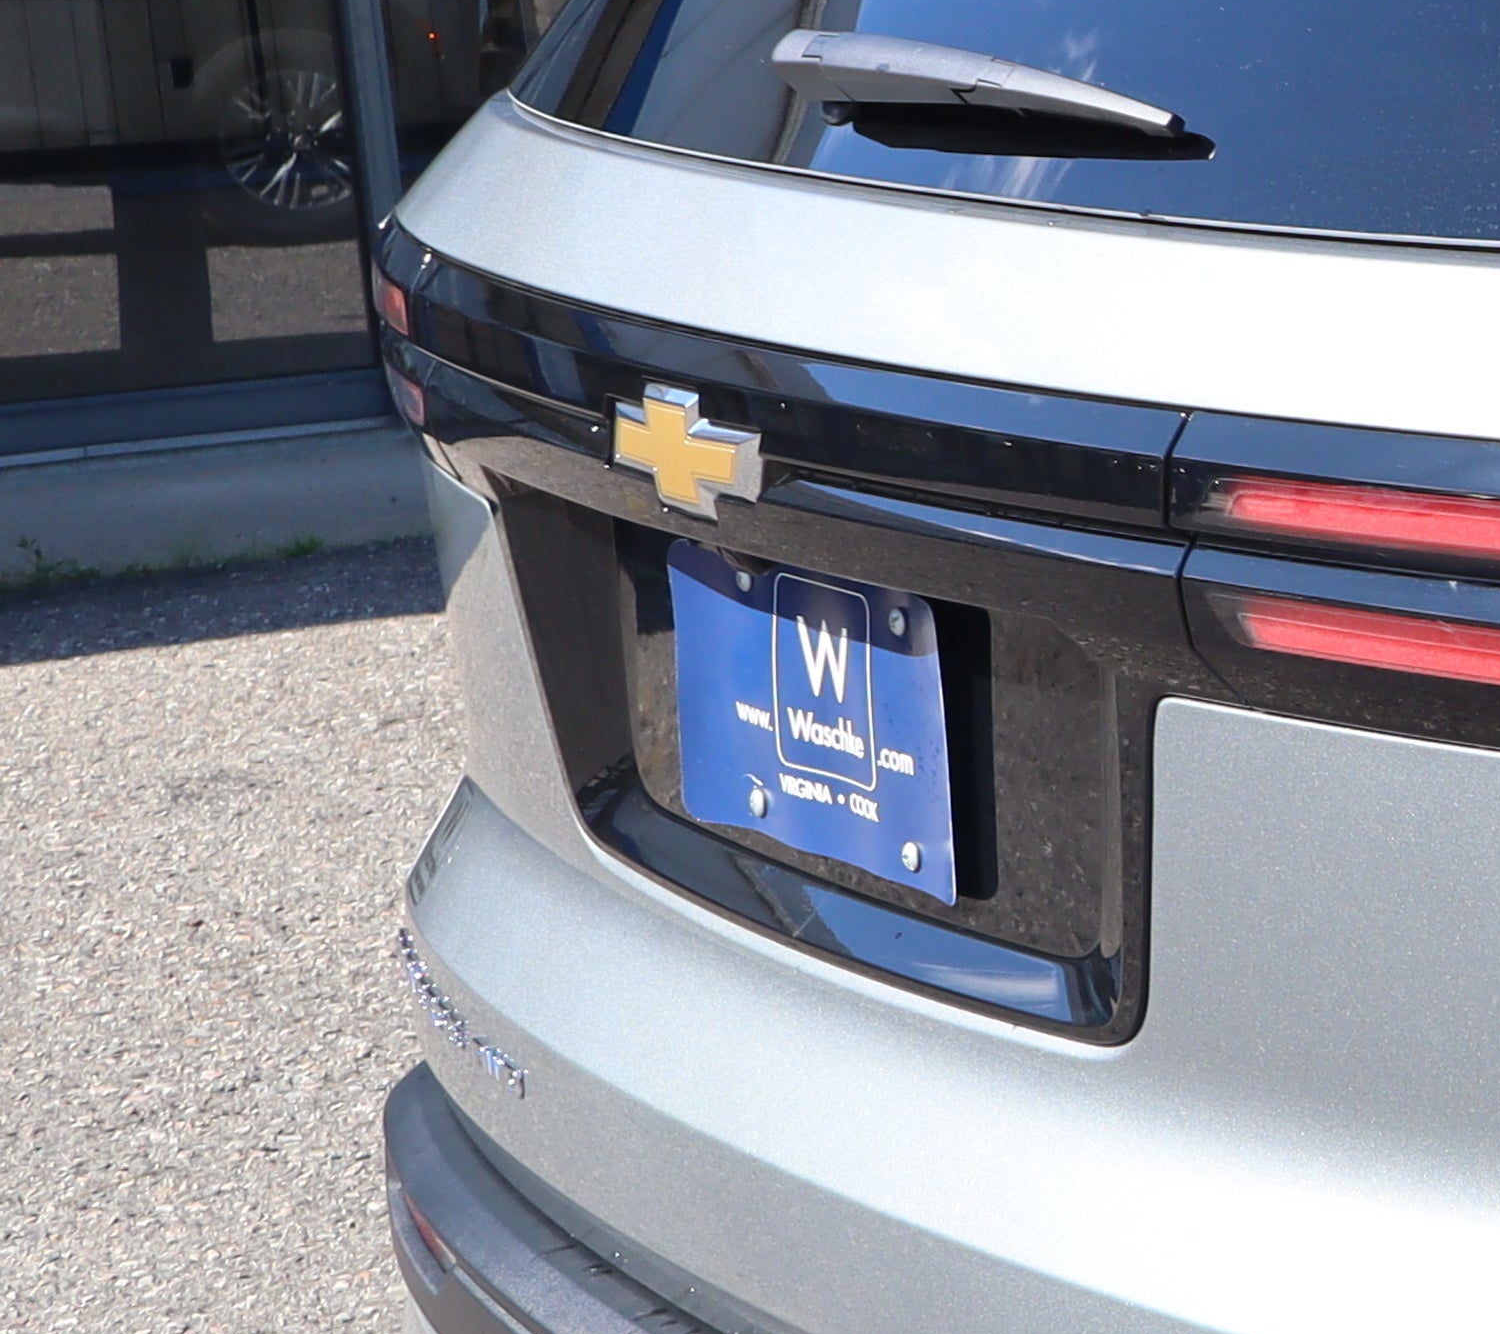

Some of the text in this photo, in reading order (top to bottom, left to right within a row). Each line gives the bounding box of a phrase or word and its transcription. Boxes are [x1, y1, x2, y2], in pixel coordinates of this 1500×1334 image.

[796, 615, 849, 703] W
[735, 701, 915, 776] www. Waschke .com
[778, 772, 880, 823] VIRGINIA COOK
